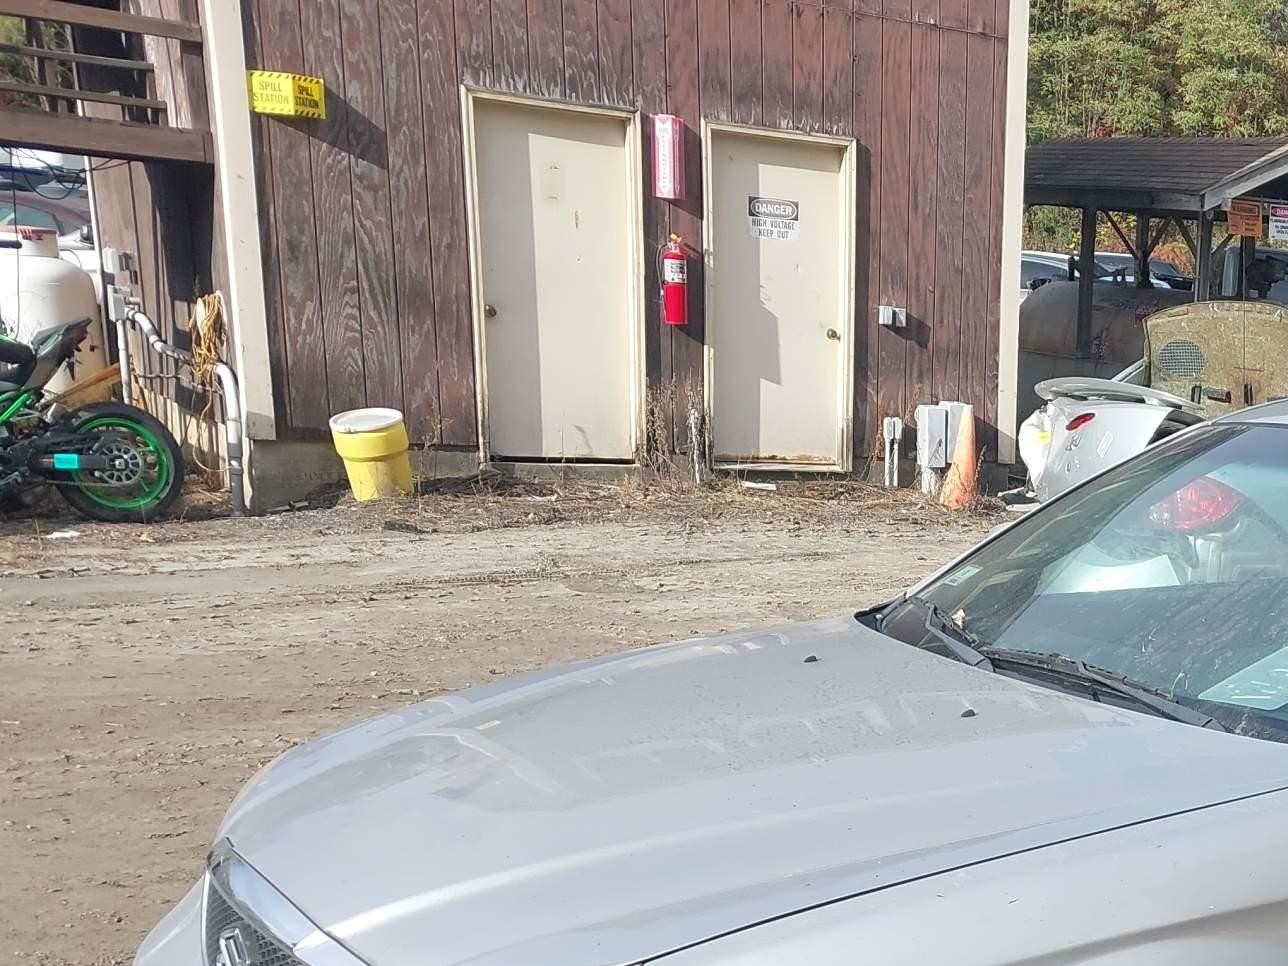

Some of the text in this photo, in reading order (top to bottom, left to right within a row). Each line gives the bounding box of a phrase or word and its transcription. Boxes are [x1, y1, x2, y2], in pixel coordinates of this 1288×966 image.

[258, 80, 282, 92] SPILL
[297, 84, 314, 97] SPILL
[253, 92, 289, 105] STATION
[295, 95, 319, 109] STATION
[755, 202, 793, 216] DANGER
[751, 217, 796, 231] HIGH VOLTAGE
[758, 228, 789, 239] KEEP OUT
